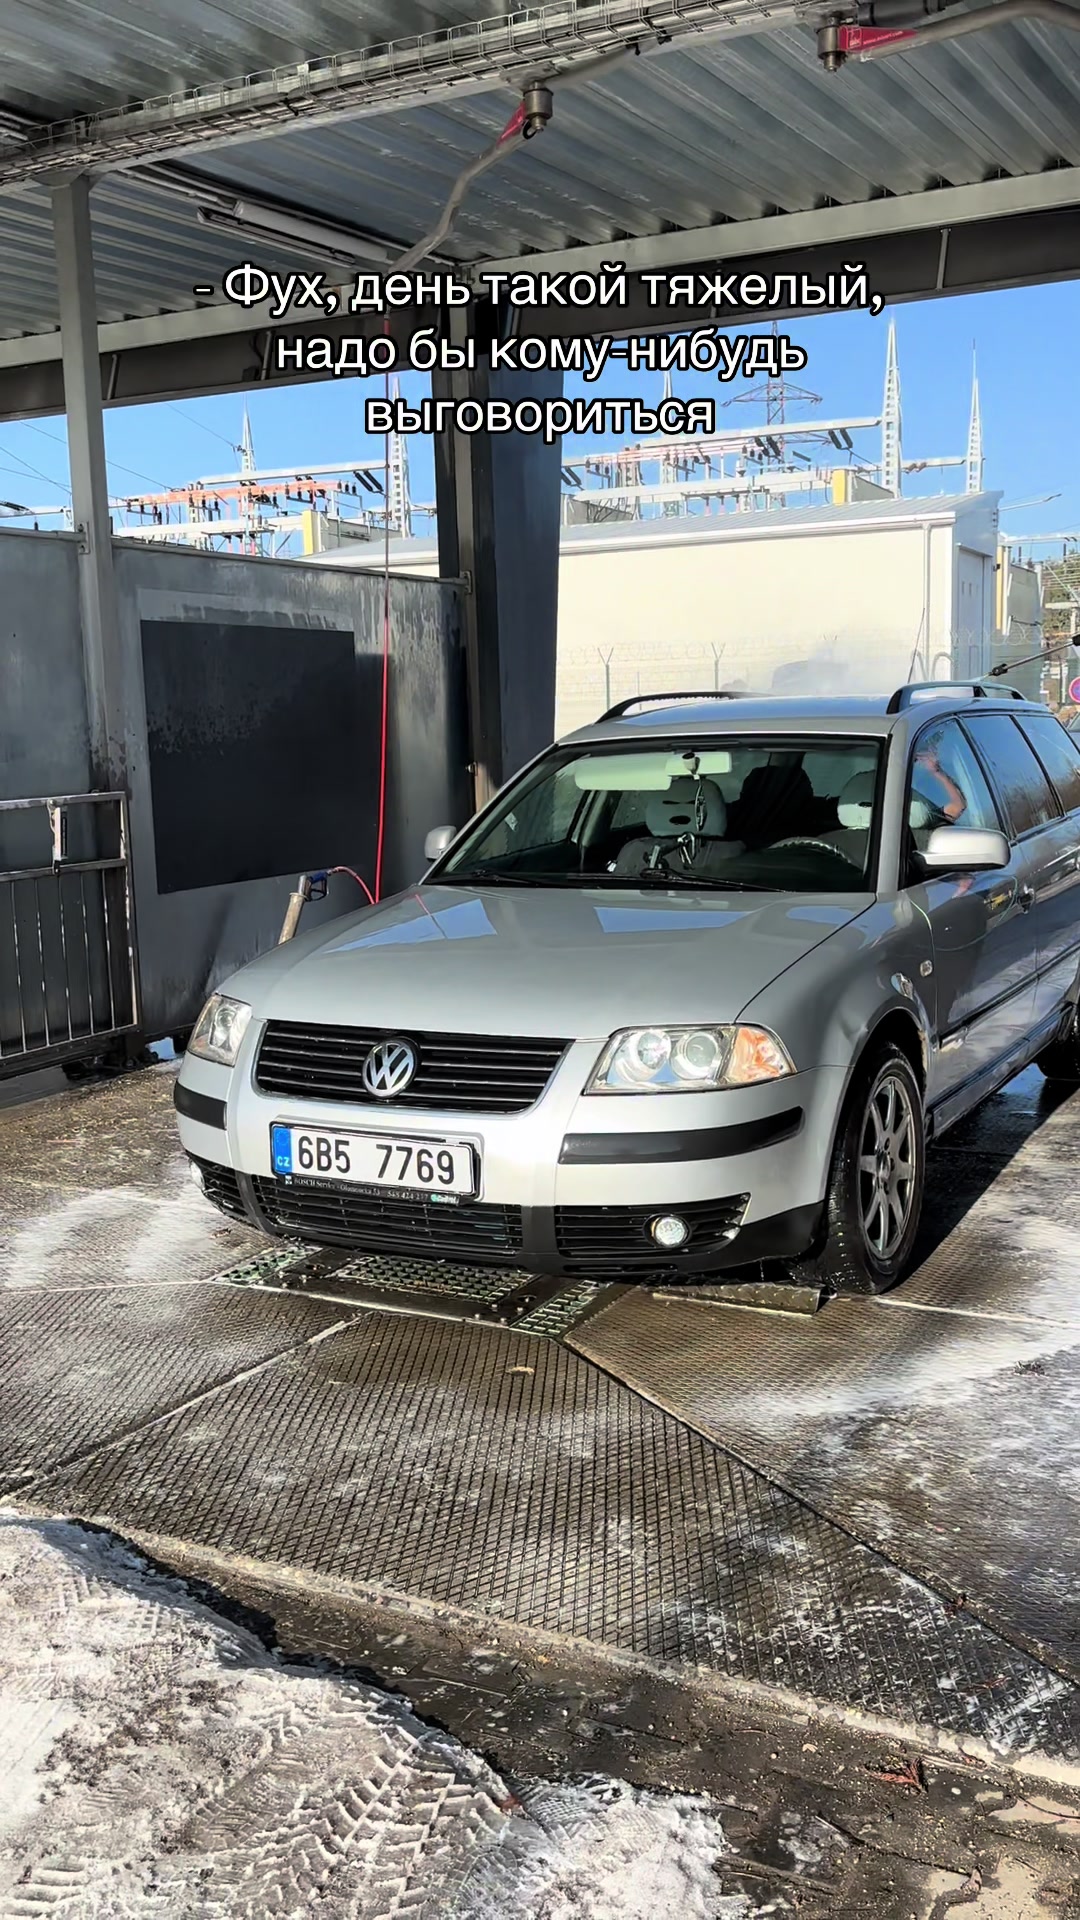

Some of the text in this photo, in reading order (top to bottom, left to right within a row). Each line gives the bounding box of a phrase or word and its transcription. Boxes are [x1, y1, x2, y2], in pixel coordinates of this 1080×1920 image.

[277, 1135, 455, 1185] CZ 6B5 7769
